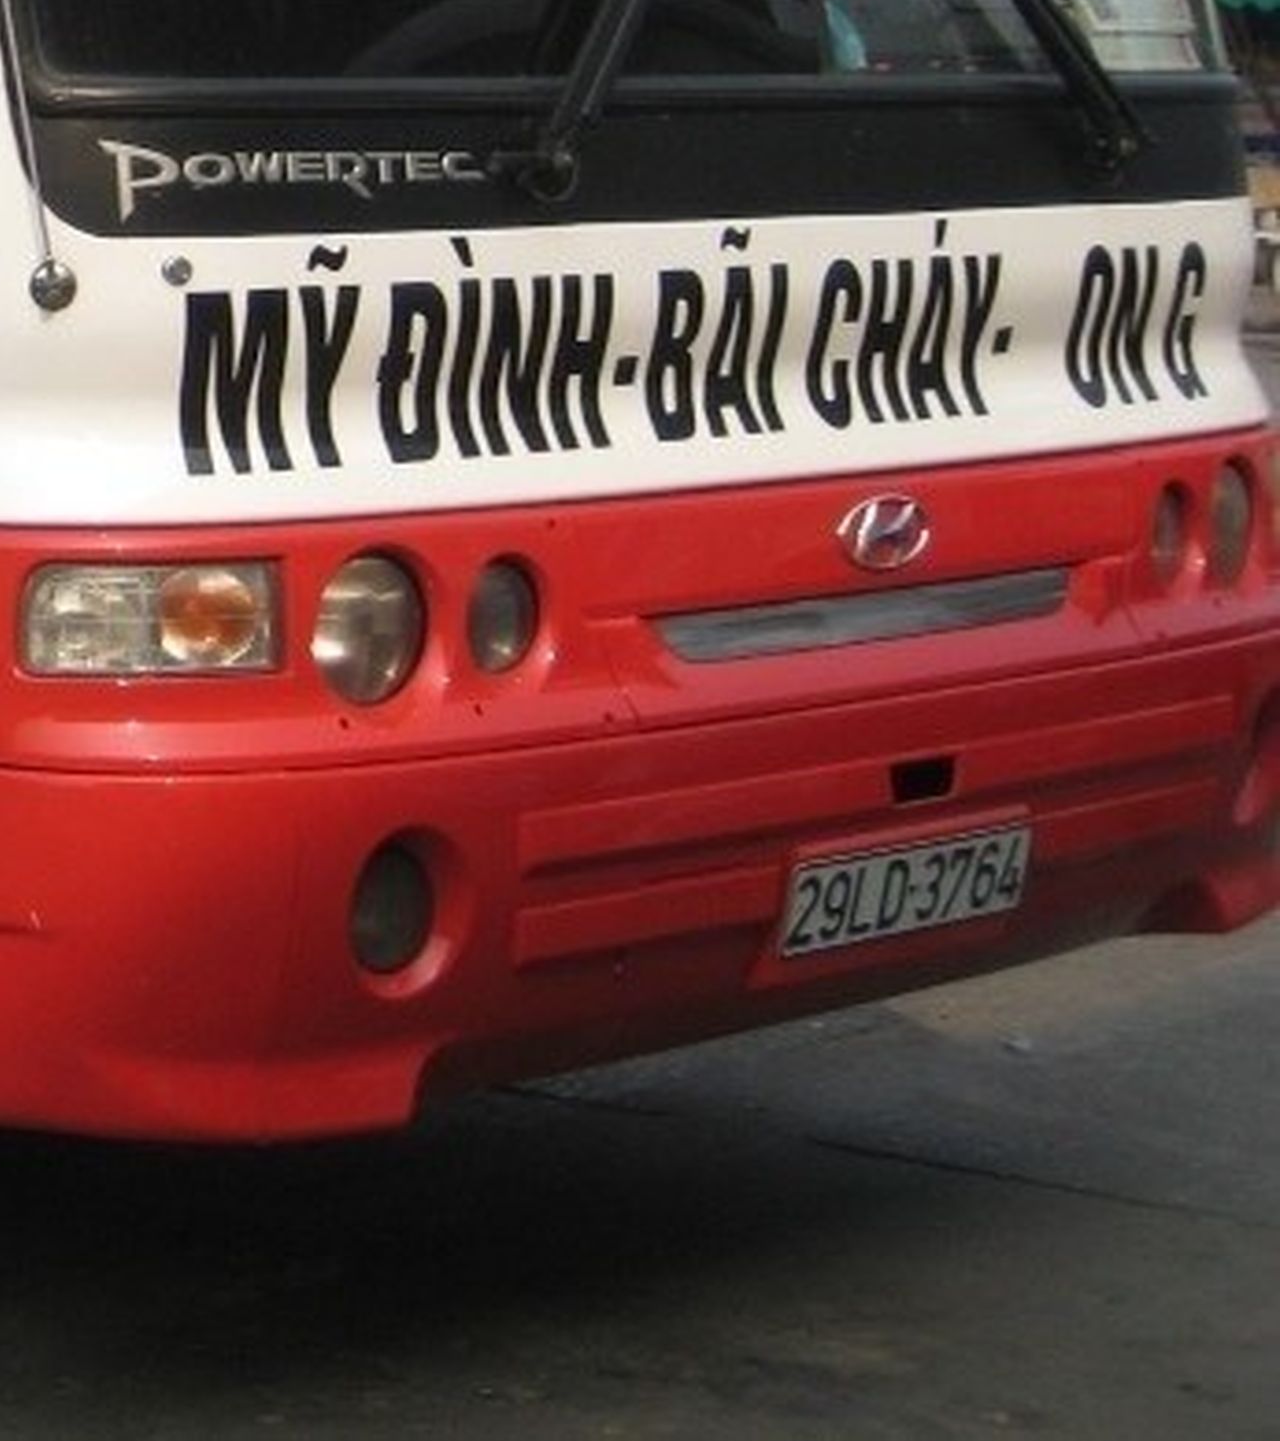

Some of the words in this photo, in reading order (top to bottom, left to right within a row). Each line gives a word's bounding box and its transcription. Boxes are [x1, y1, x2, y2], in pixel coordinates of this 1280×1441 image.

[98, 139, 486, 224] POWERTEC
[179, 244, 361, 476] MỸ
[788, 835, 1021, 947] 29LD-3764
